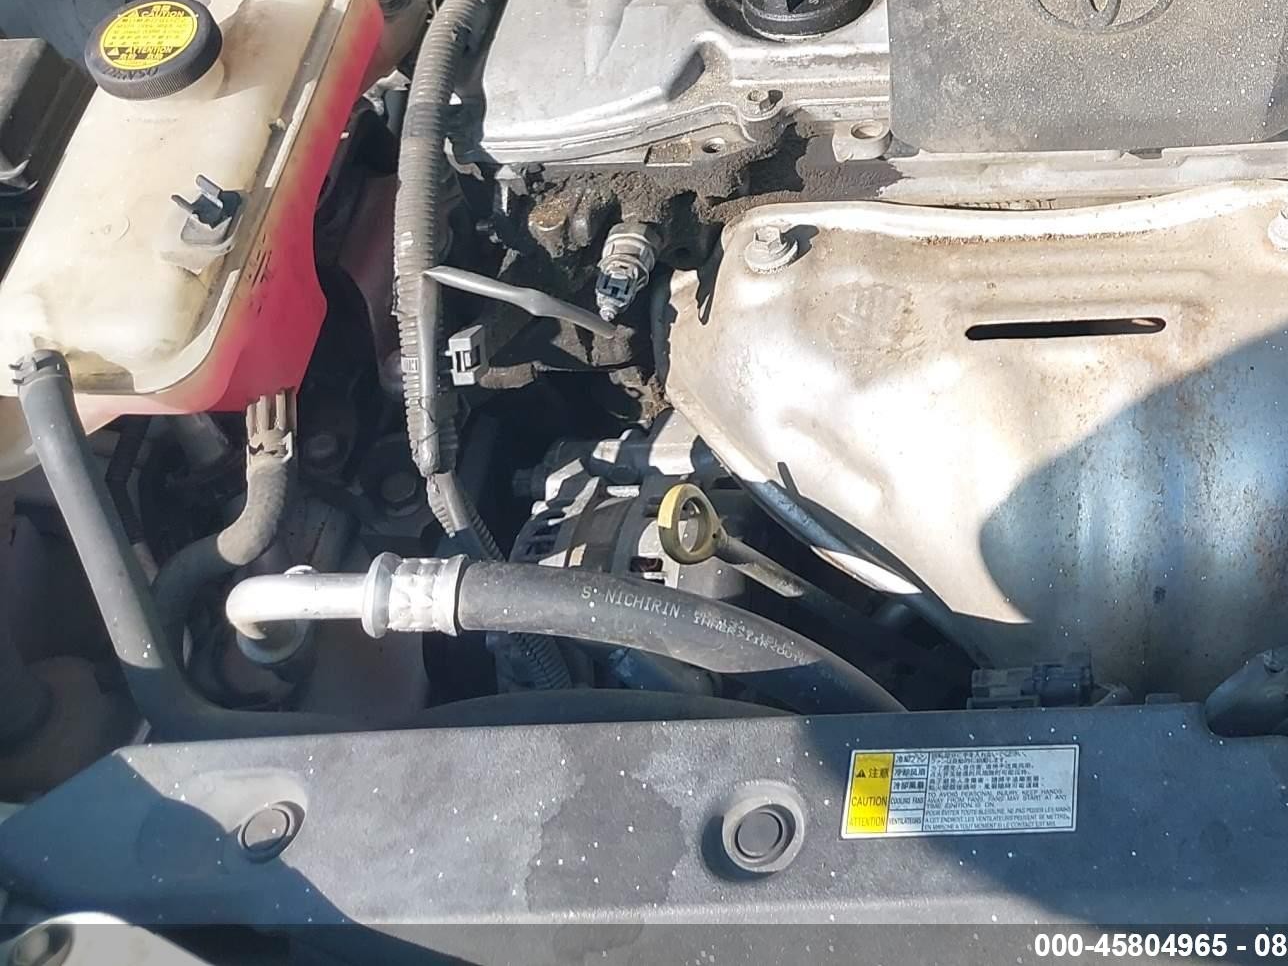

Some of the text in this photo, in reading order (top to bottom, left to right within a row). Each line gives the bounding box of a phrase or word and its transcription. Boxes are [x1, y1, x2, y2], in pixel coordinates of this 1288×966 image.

[141, 10, 185, 18] CAUTION
[604, 591, 681, 619] NICHIRIN
[868, 767, 889, 779] 注意
[851, 795, 888, 807] CAUTION
[848, 815, 886, 828] ATTENTION
